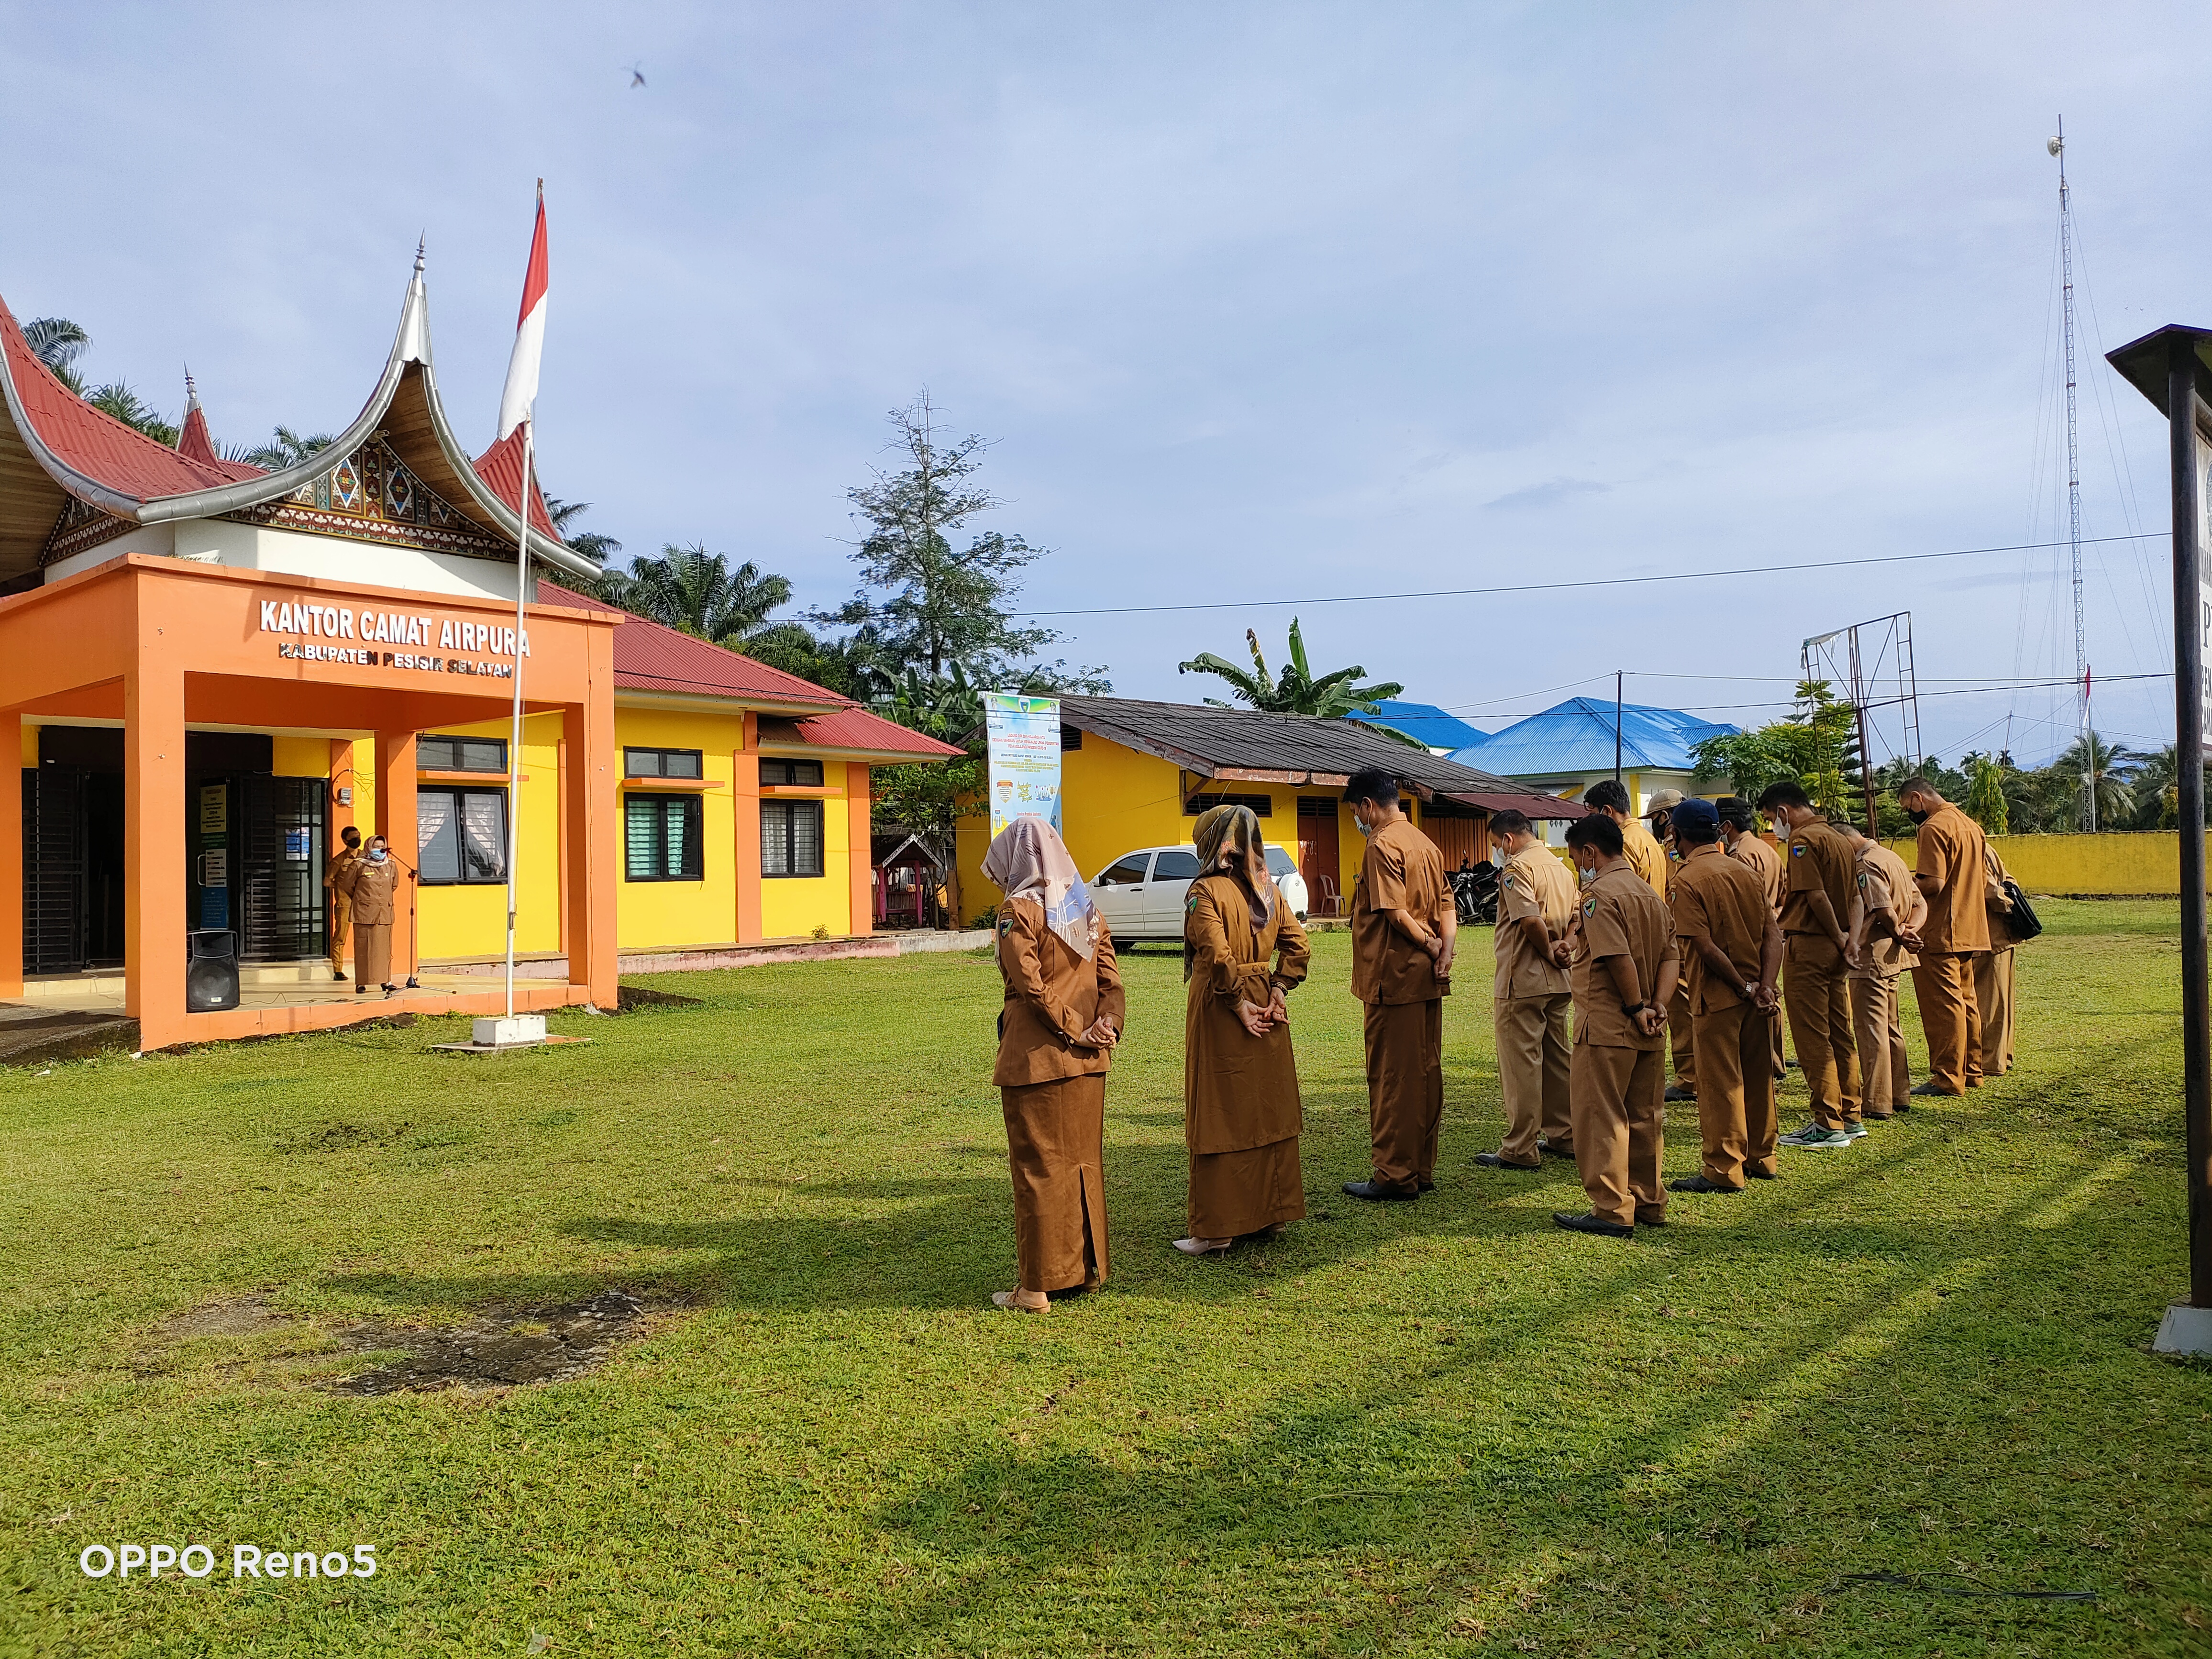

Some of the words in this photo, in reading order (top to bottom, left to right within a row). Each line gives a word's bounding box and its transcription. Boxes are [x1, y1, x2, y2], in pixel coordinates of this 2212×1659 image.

[260, 600, 354, 639] KANTOR
[359, 611, 432, 646] CAMAT
[438, 620, 531, 658] AIRPURA
[279, 642, 378, 665] KABUPATEN
[383, 652, 444, 672] PESISIR
[447, 659, 512, 678] SELATAN
